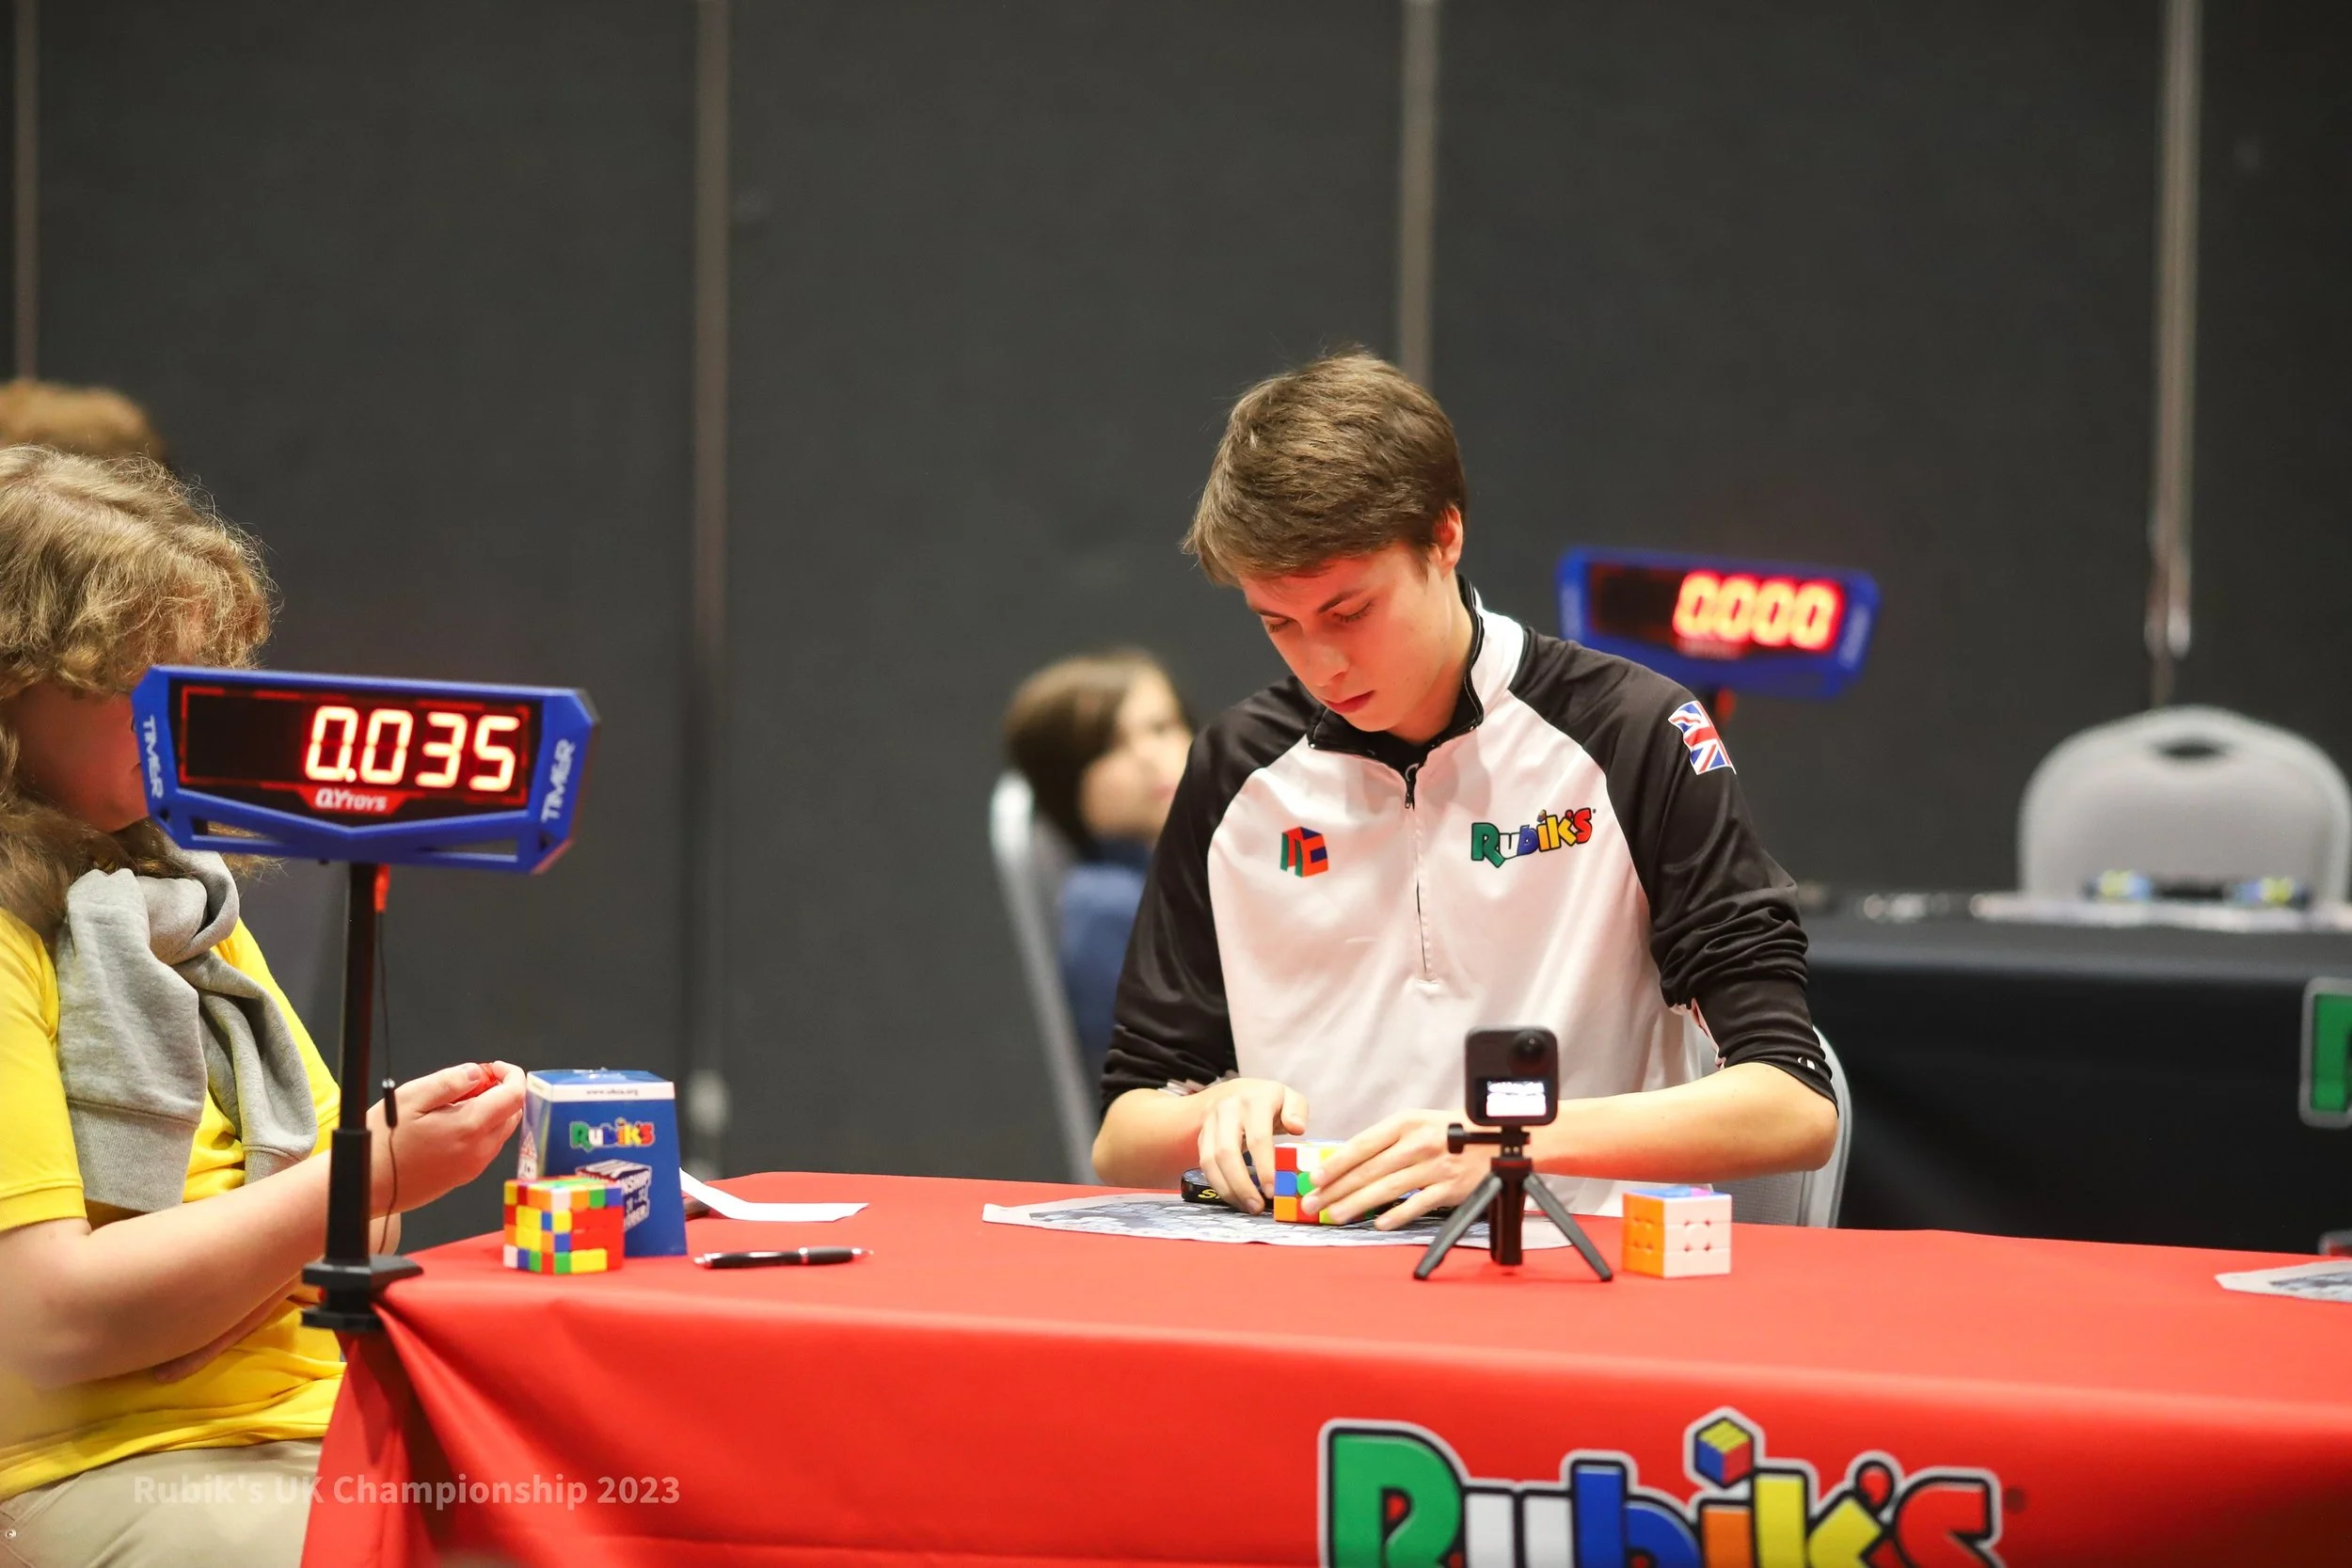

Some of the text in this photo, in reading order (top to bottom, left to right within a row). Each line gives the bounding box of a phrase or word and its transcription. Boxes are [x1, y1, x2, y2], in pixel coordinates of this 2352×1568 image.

[143, 714, 165, 800] TIMER
[305, 705, 521, 793] 0.035
[541, 737, 577, 824] TIMER
